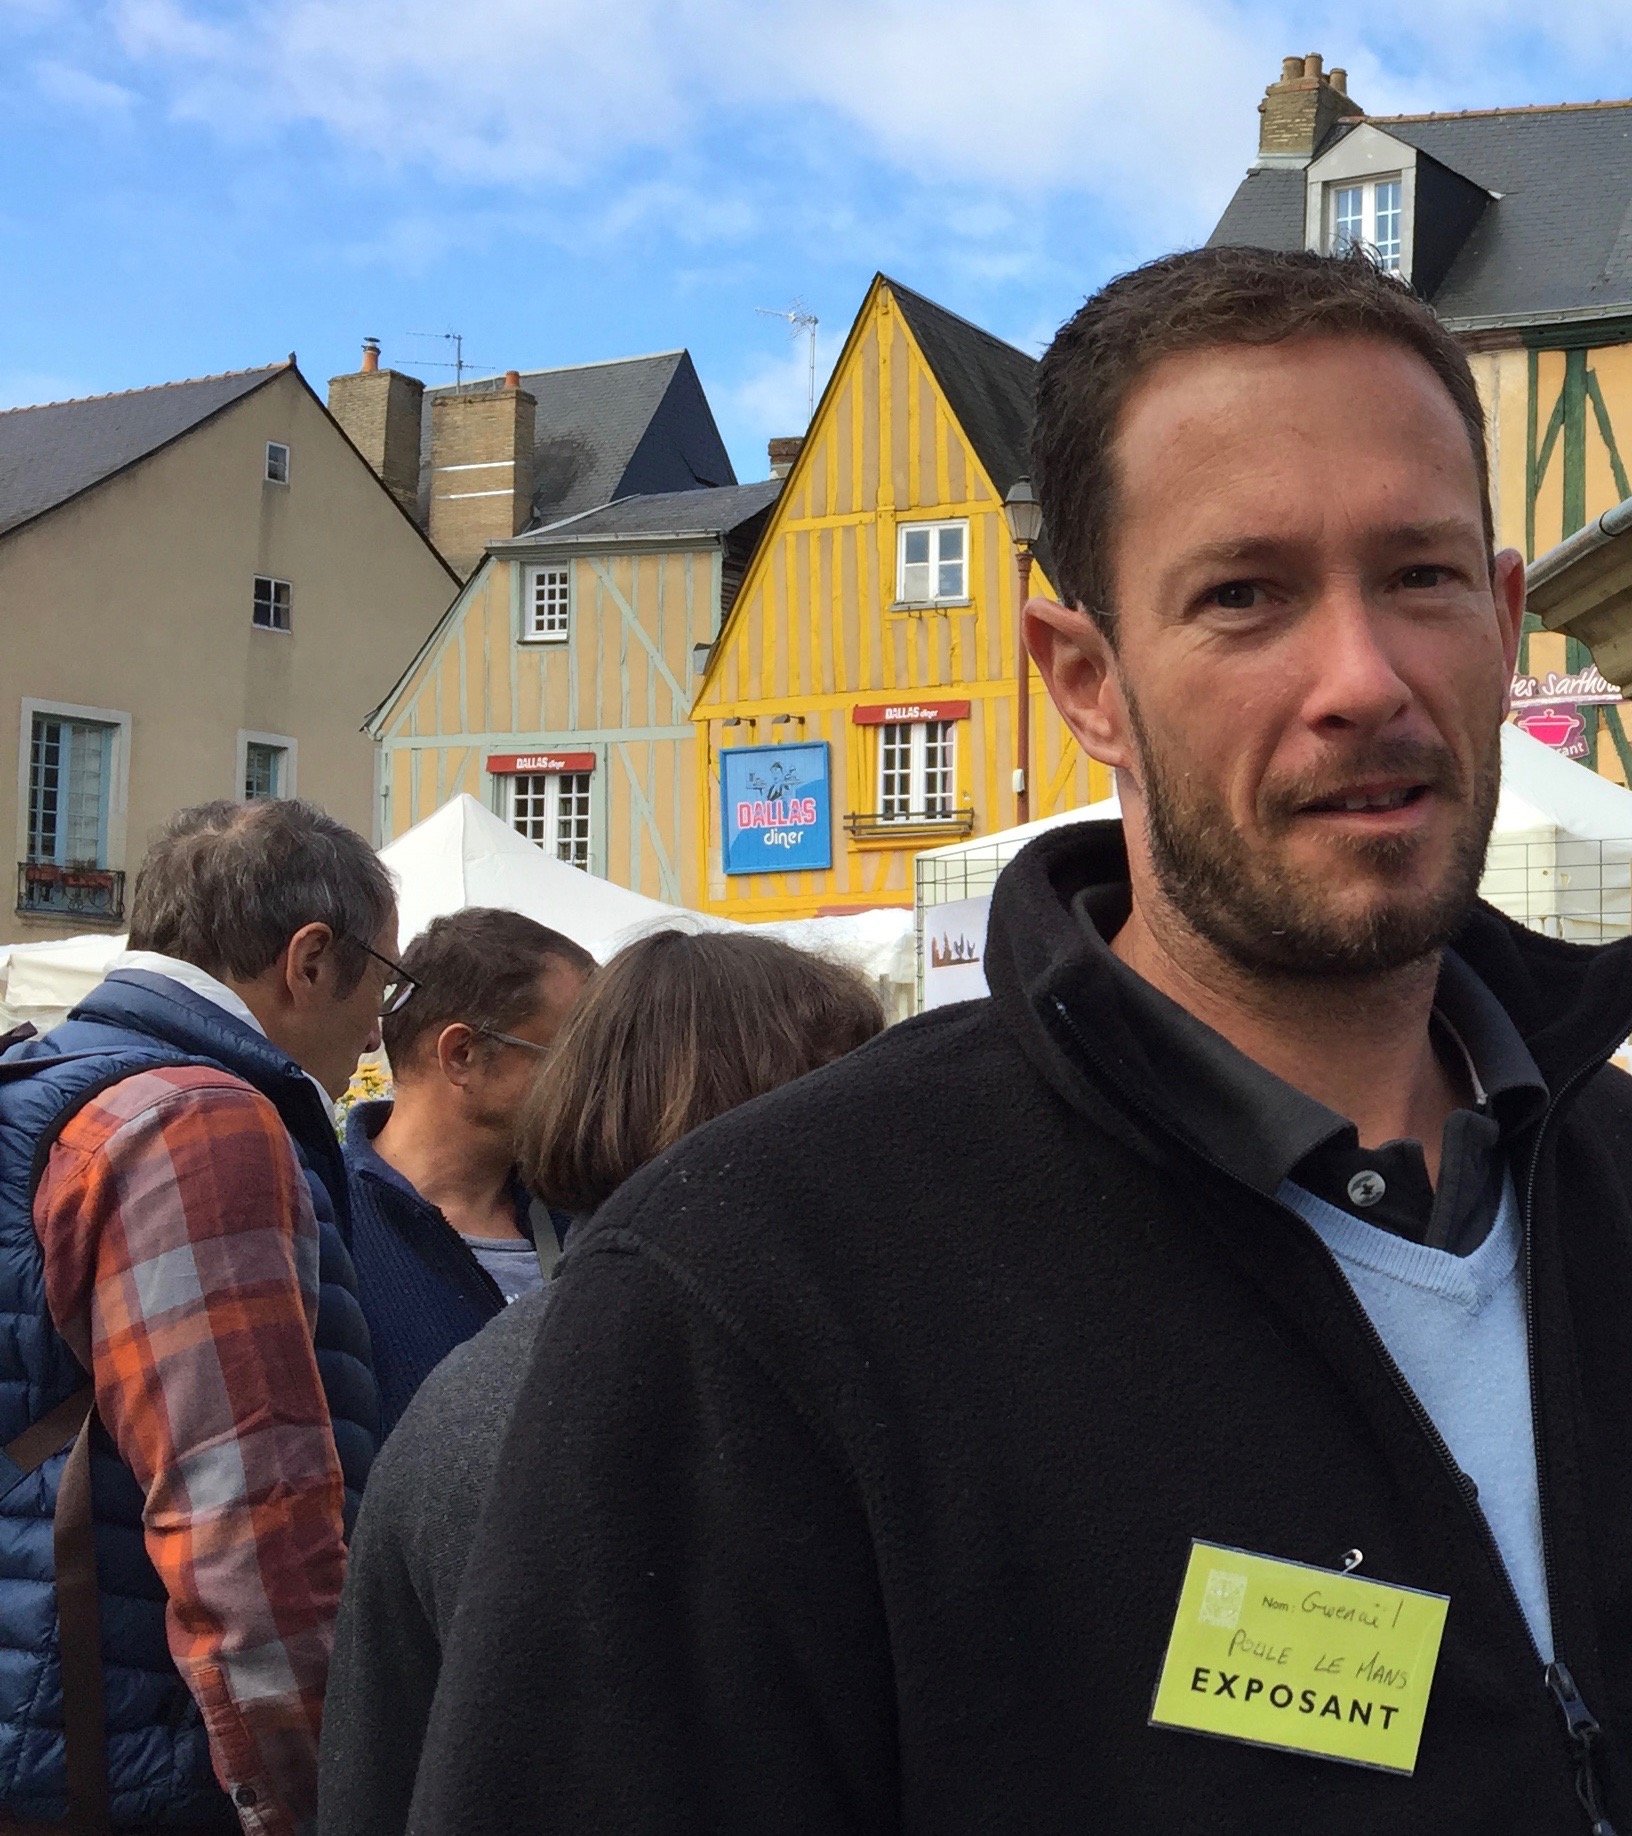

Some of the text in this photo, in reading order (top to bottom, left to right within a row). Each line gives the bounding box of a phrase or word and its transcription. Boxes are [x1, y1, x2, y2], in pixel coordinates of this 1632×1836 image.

[885, 706, 919, 719] DALLAS
[516, 757, 548, 769] DALLAS
[738, 798, 816, 829] DALLAS
[763, 828, 804, 849] diner
[1228, 1628, 1408, 1690] POULE LE MANS
[1191, 1666, 1399, 1730] EXPOSANT
